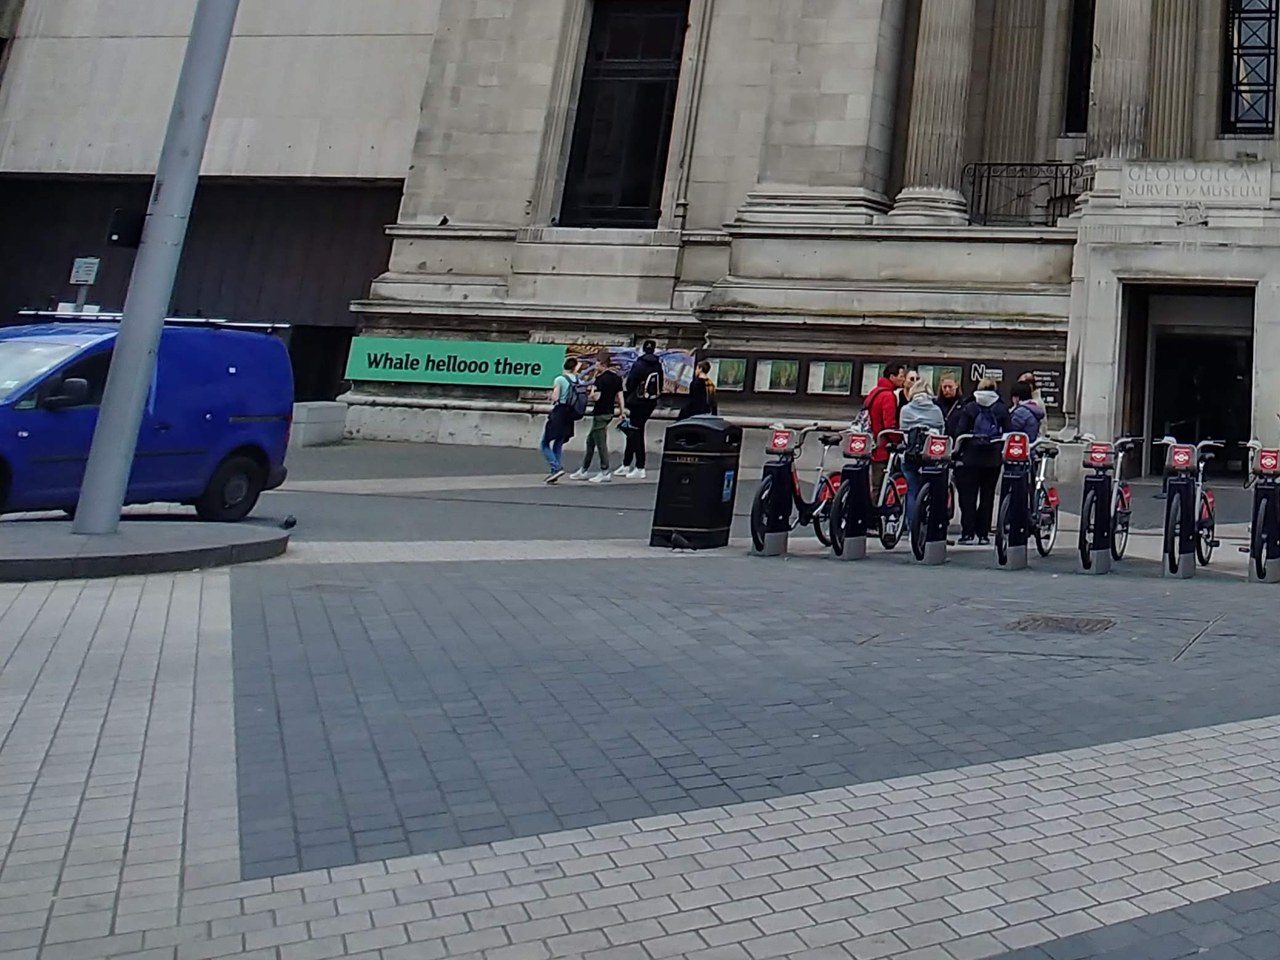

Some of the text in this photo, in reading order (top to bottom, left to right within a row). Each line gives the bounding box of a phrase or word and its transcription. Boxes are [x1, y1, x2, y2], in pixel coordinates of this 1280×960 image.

[1128, 165, 1259, 183] GEOLOGICAL
[1127, 183, 1181, 196] SURVEY
[1199, 184, 1262, 198] MUSEUM
[367, 352, 542, 376] Whale hellooo there
